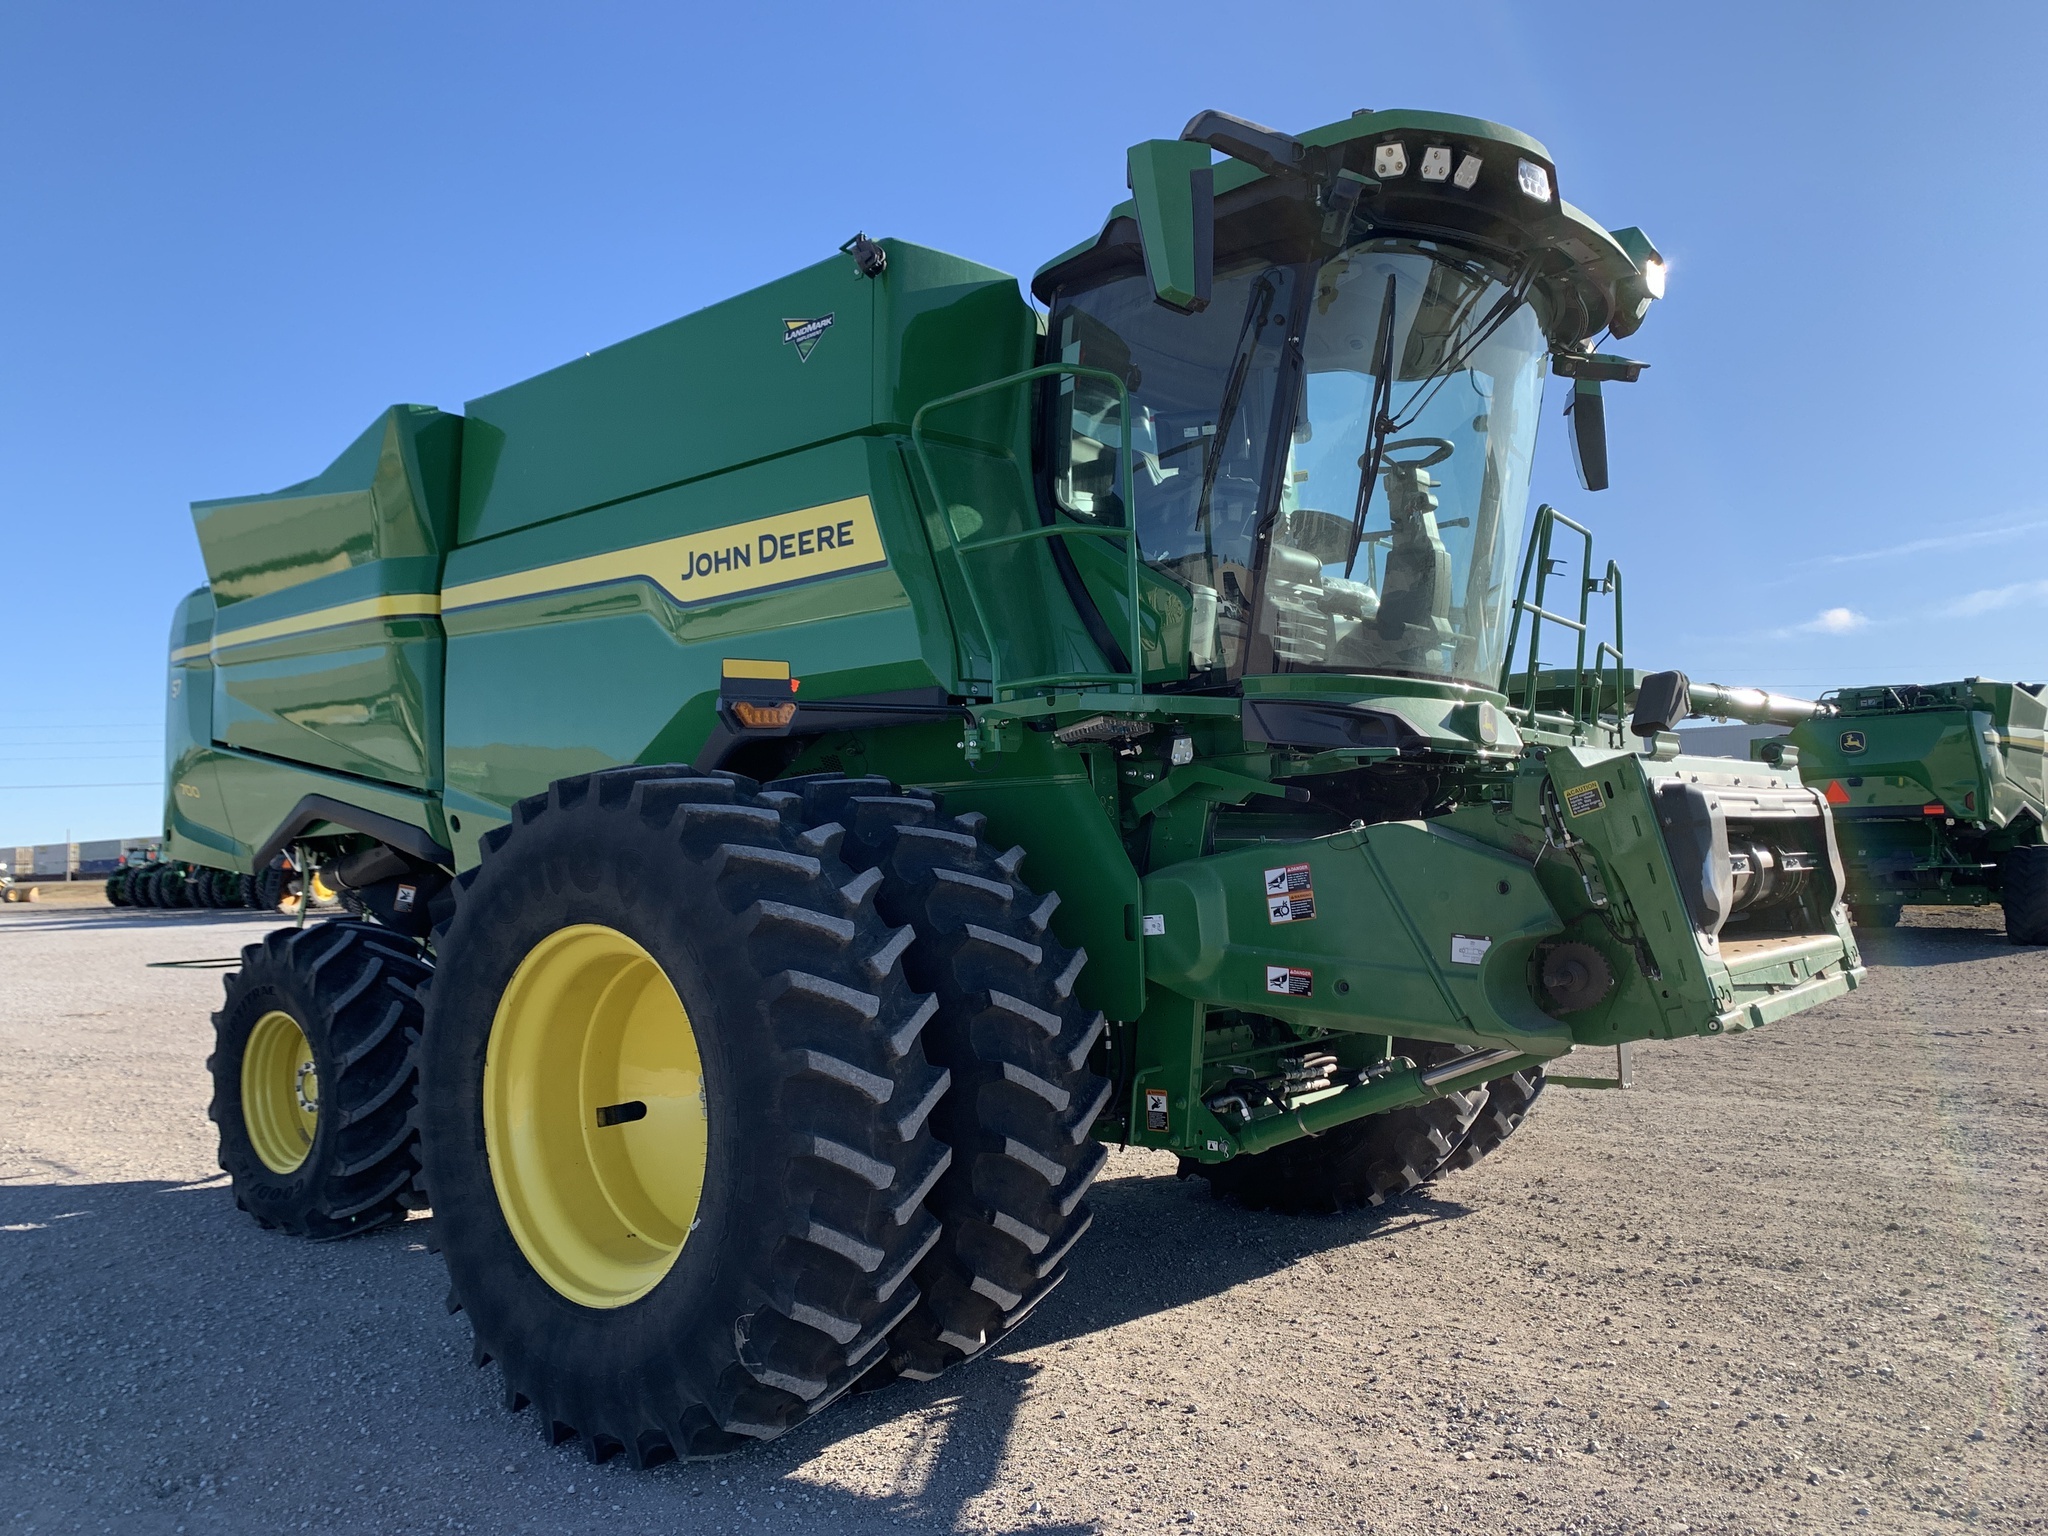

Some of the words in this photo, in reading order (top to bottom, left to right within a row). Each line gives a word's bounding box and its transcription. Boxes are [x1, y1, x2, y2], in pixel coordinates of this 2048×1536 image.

[785, 317, 832, 341] LANDMARK
[681, 544, 751, 581] JOHN
[758, 520, 854, 564] DEERE
[178, 782, 200, 799] 700
[1570, 782, 1597, 795] CAUTION
